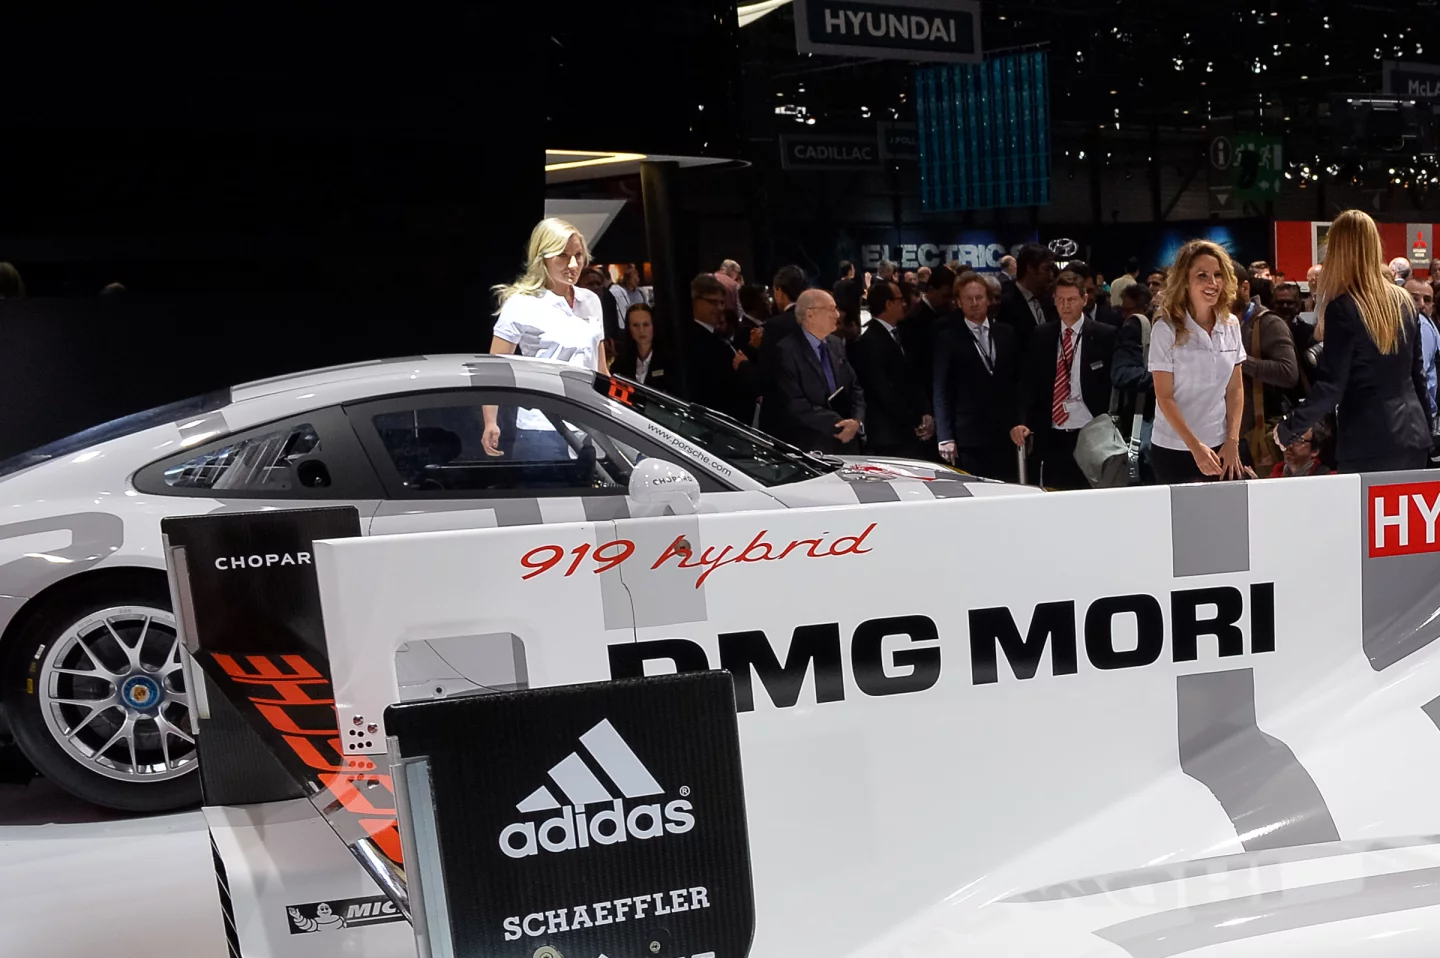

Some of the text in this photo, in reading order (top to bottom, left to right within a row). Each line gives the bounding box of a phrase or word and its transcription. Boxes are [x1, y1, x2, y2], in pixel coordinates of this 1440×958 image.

[824, 9, 956, 43] HYUNDAI
[793, 144, 873, 161] CADILLAC
[647, 423, 732, 477] www.porsche.com
[214, 551, 312, 571] CHOPAR
[520, 522, 878, 590] 919 hybrid
[967, 581, 1276, 686] MORI
[498, 797, 696, 859] adidas
[503, 885, 711, 941] SCHAEFFLER
